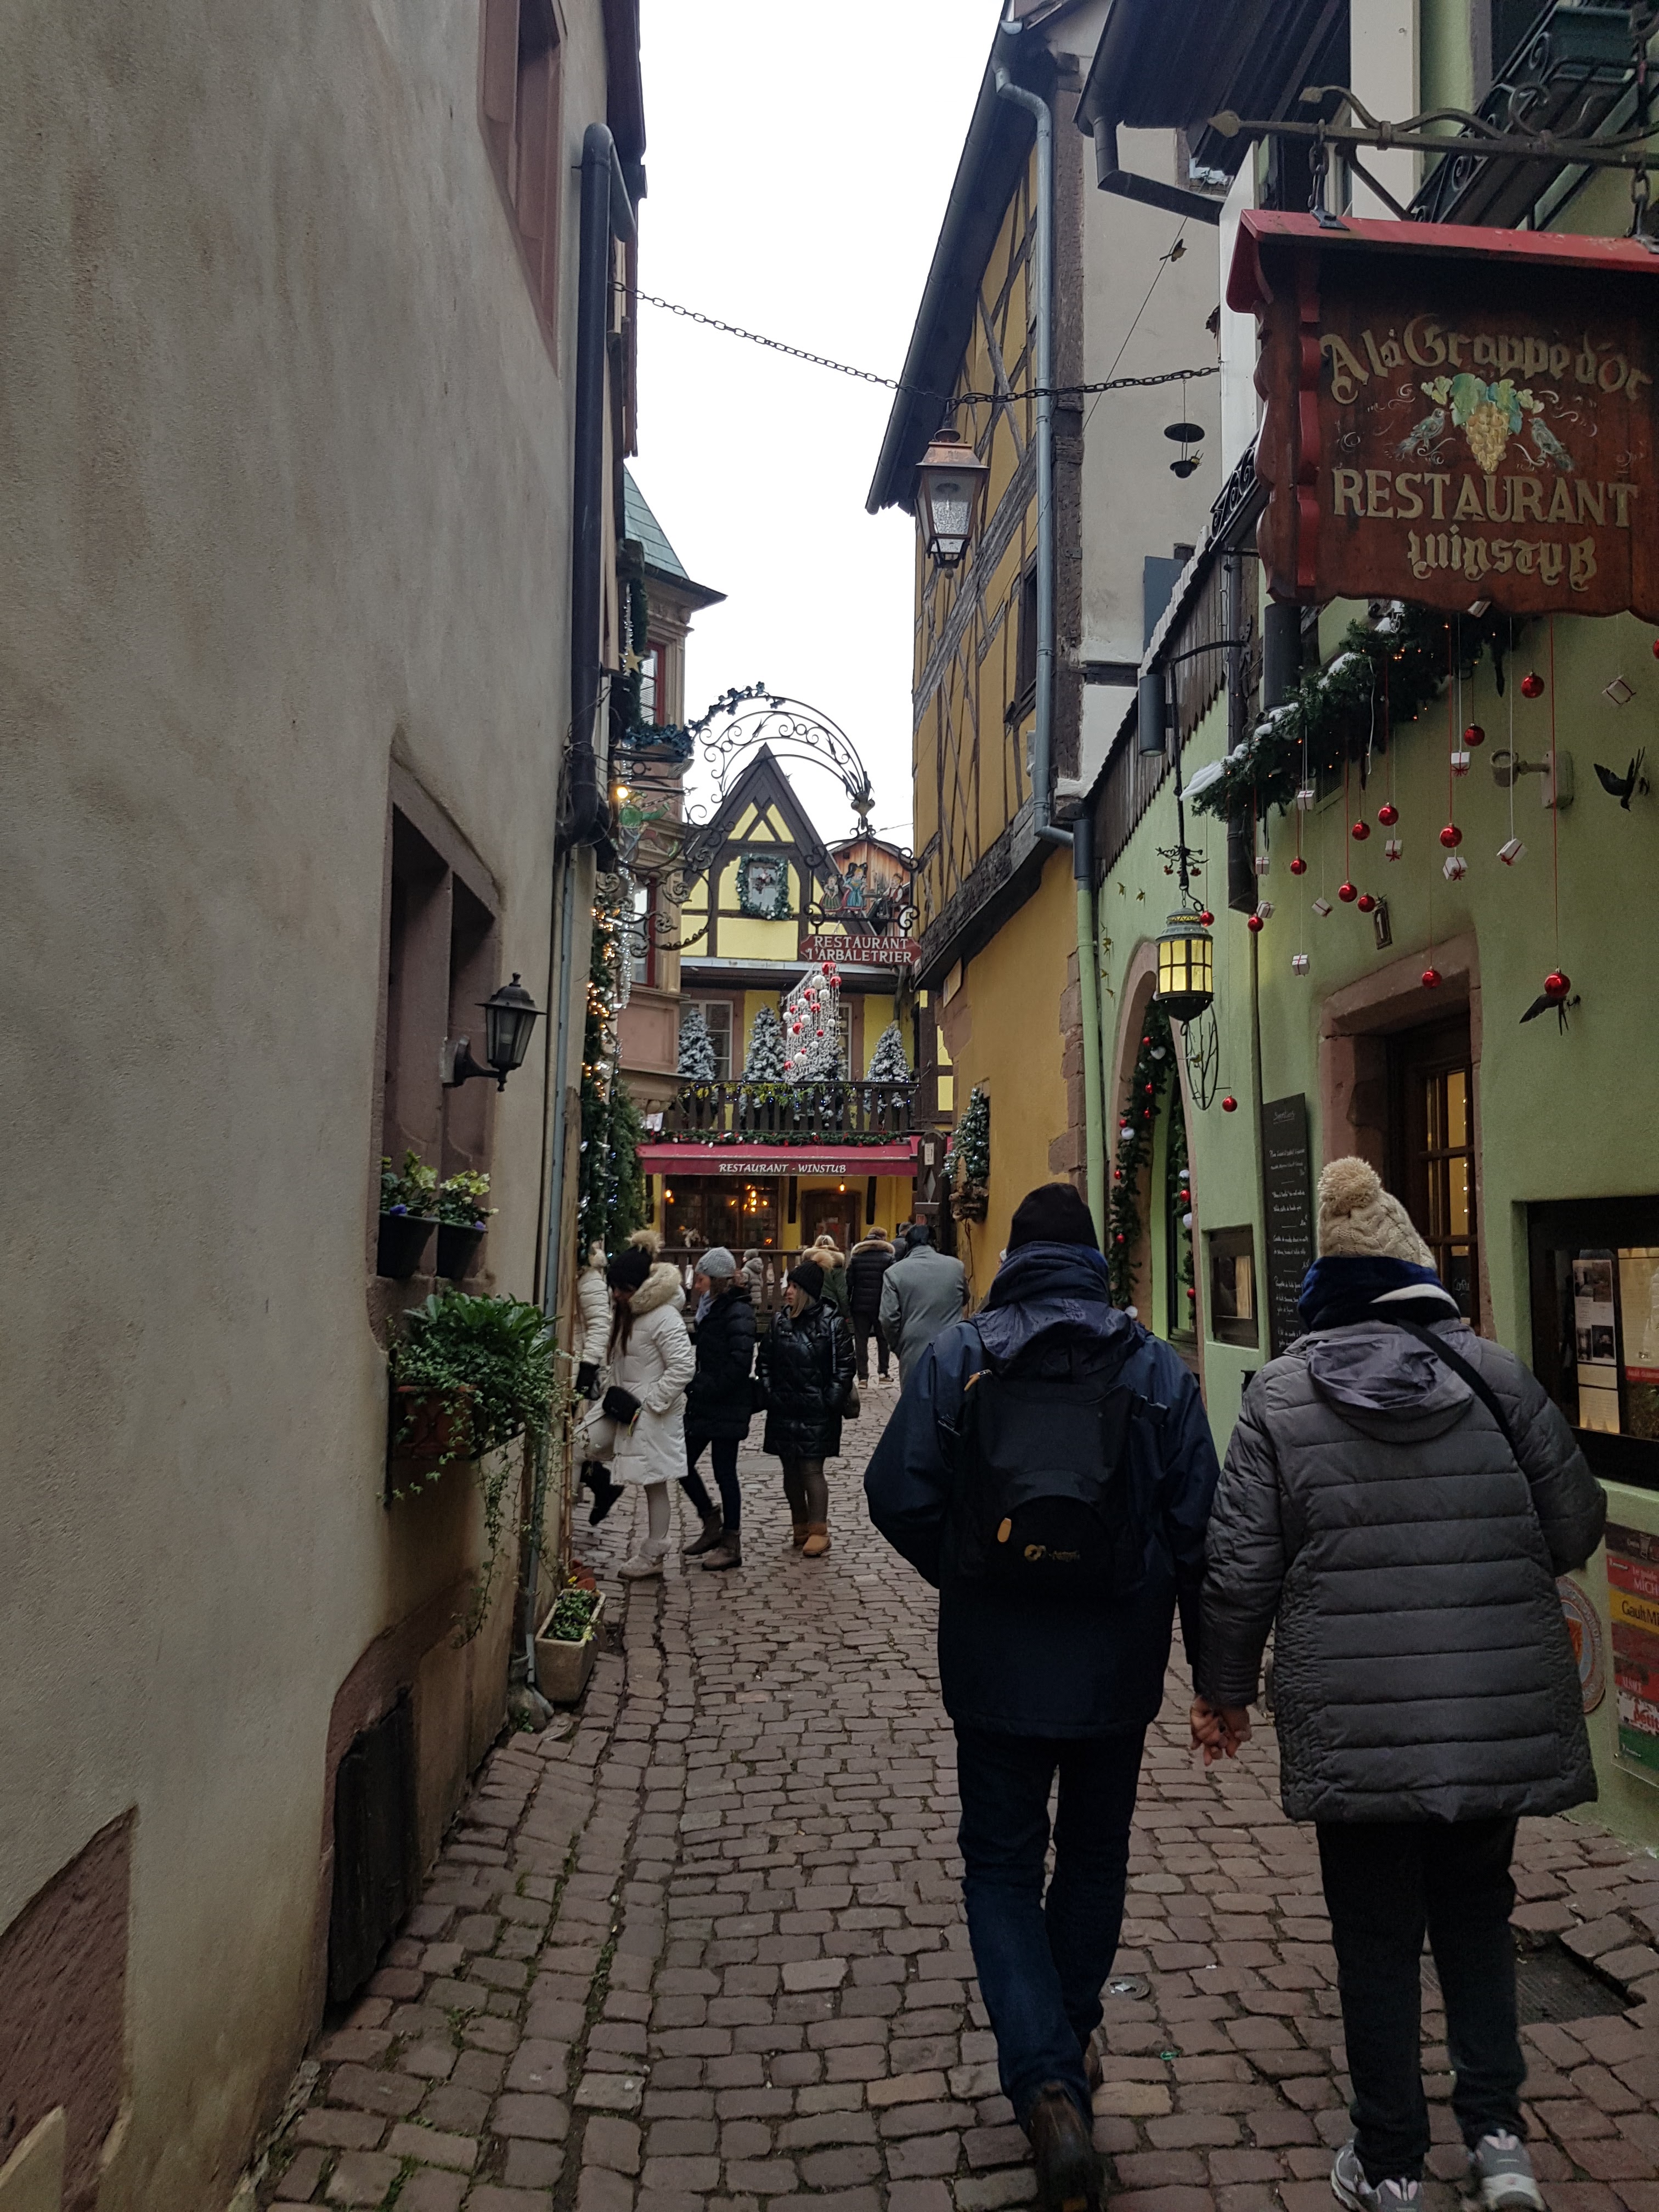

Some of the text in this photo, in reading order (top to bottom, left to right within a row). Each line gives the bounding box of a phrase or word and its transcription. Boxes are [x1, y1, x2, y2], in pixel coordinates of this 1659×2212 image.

[1403, 313, 1571, 380] Grappe
[1332, 468, 1639, 528] RESTAURANT
[1376, 913, 1385, 939] 1
[814, 935, 908, 950] RESTAURANT
[719, 1163, 789, 1173] RESTAURANT
[798, 1163, 847, 1173] WINSTUB
[1633, 1577, 1659, 1596] MICH
